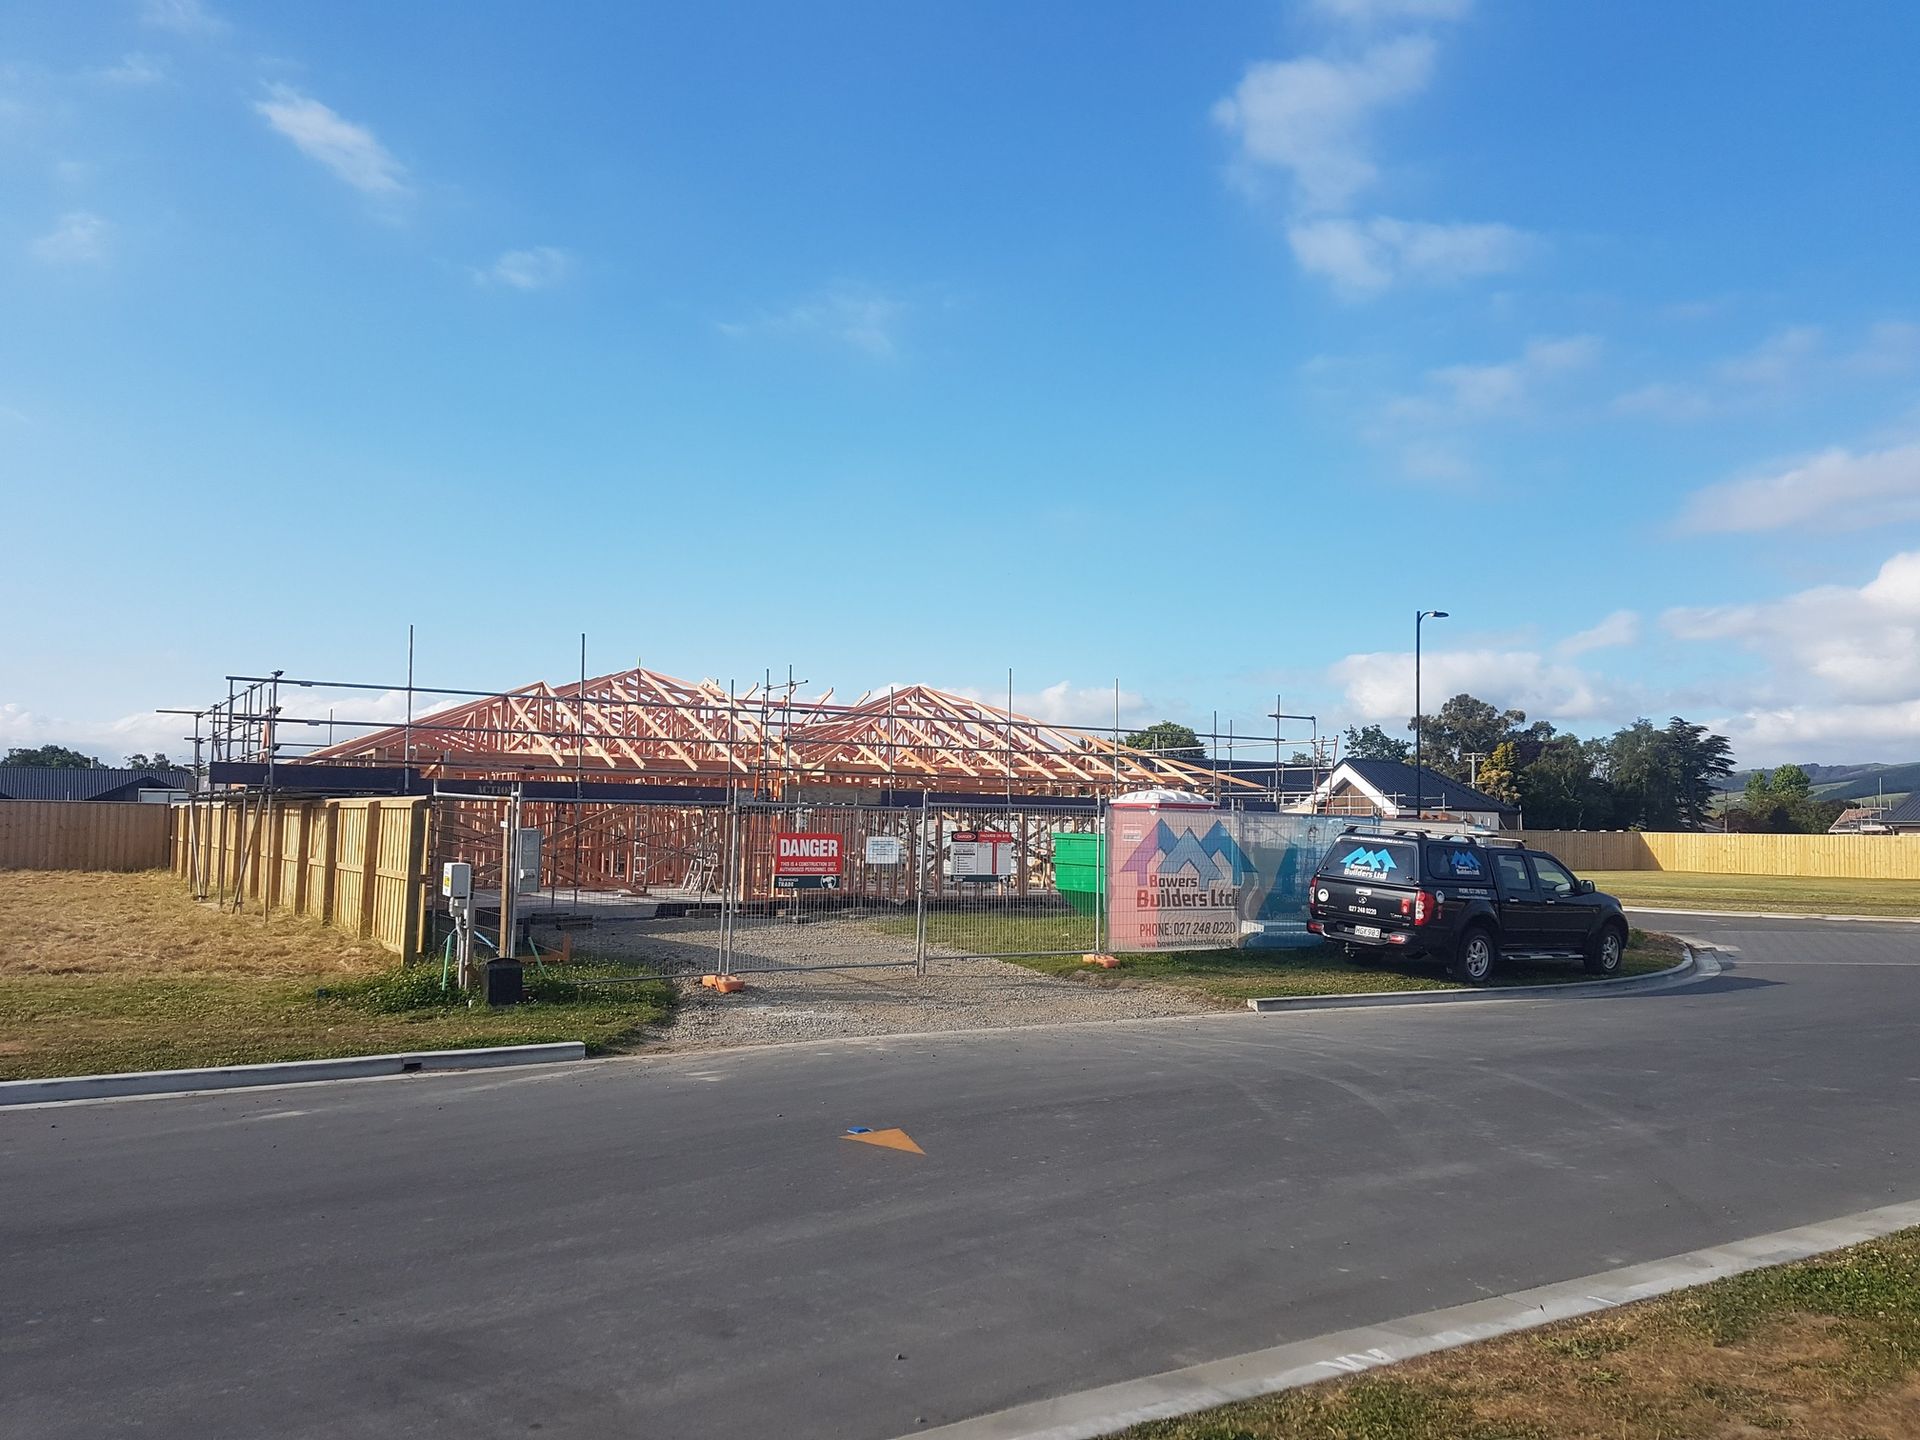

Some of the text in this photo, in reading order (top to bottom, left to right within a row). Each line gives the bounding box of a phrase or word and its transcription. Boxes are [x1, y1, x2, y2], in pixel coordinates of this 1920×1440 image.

[780, 839, 838, 857] DANGER
[1149, 874, 1197, 888] Bowers
[1343, 868, 1374, 878] Builders
[1137, 888, 1236, 908] Builders Ltd
[1140, 921, 1236, 937] PHONE: 027 248 0220
